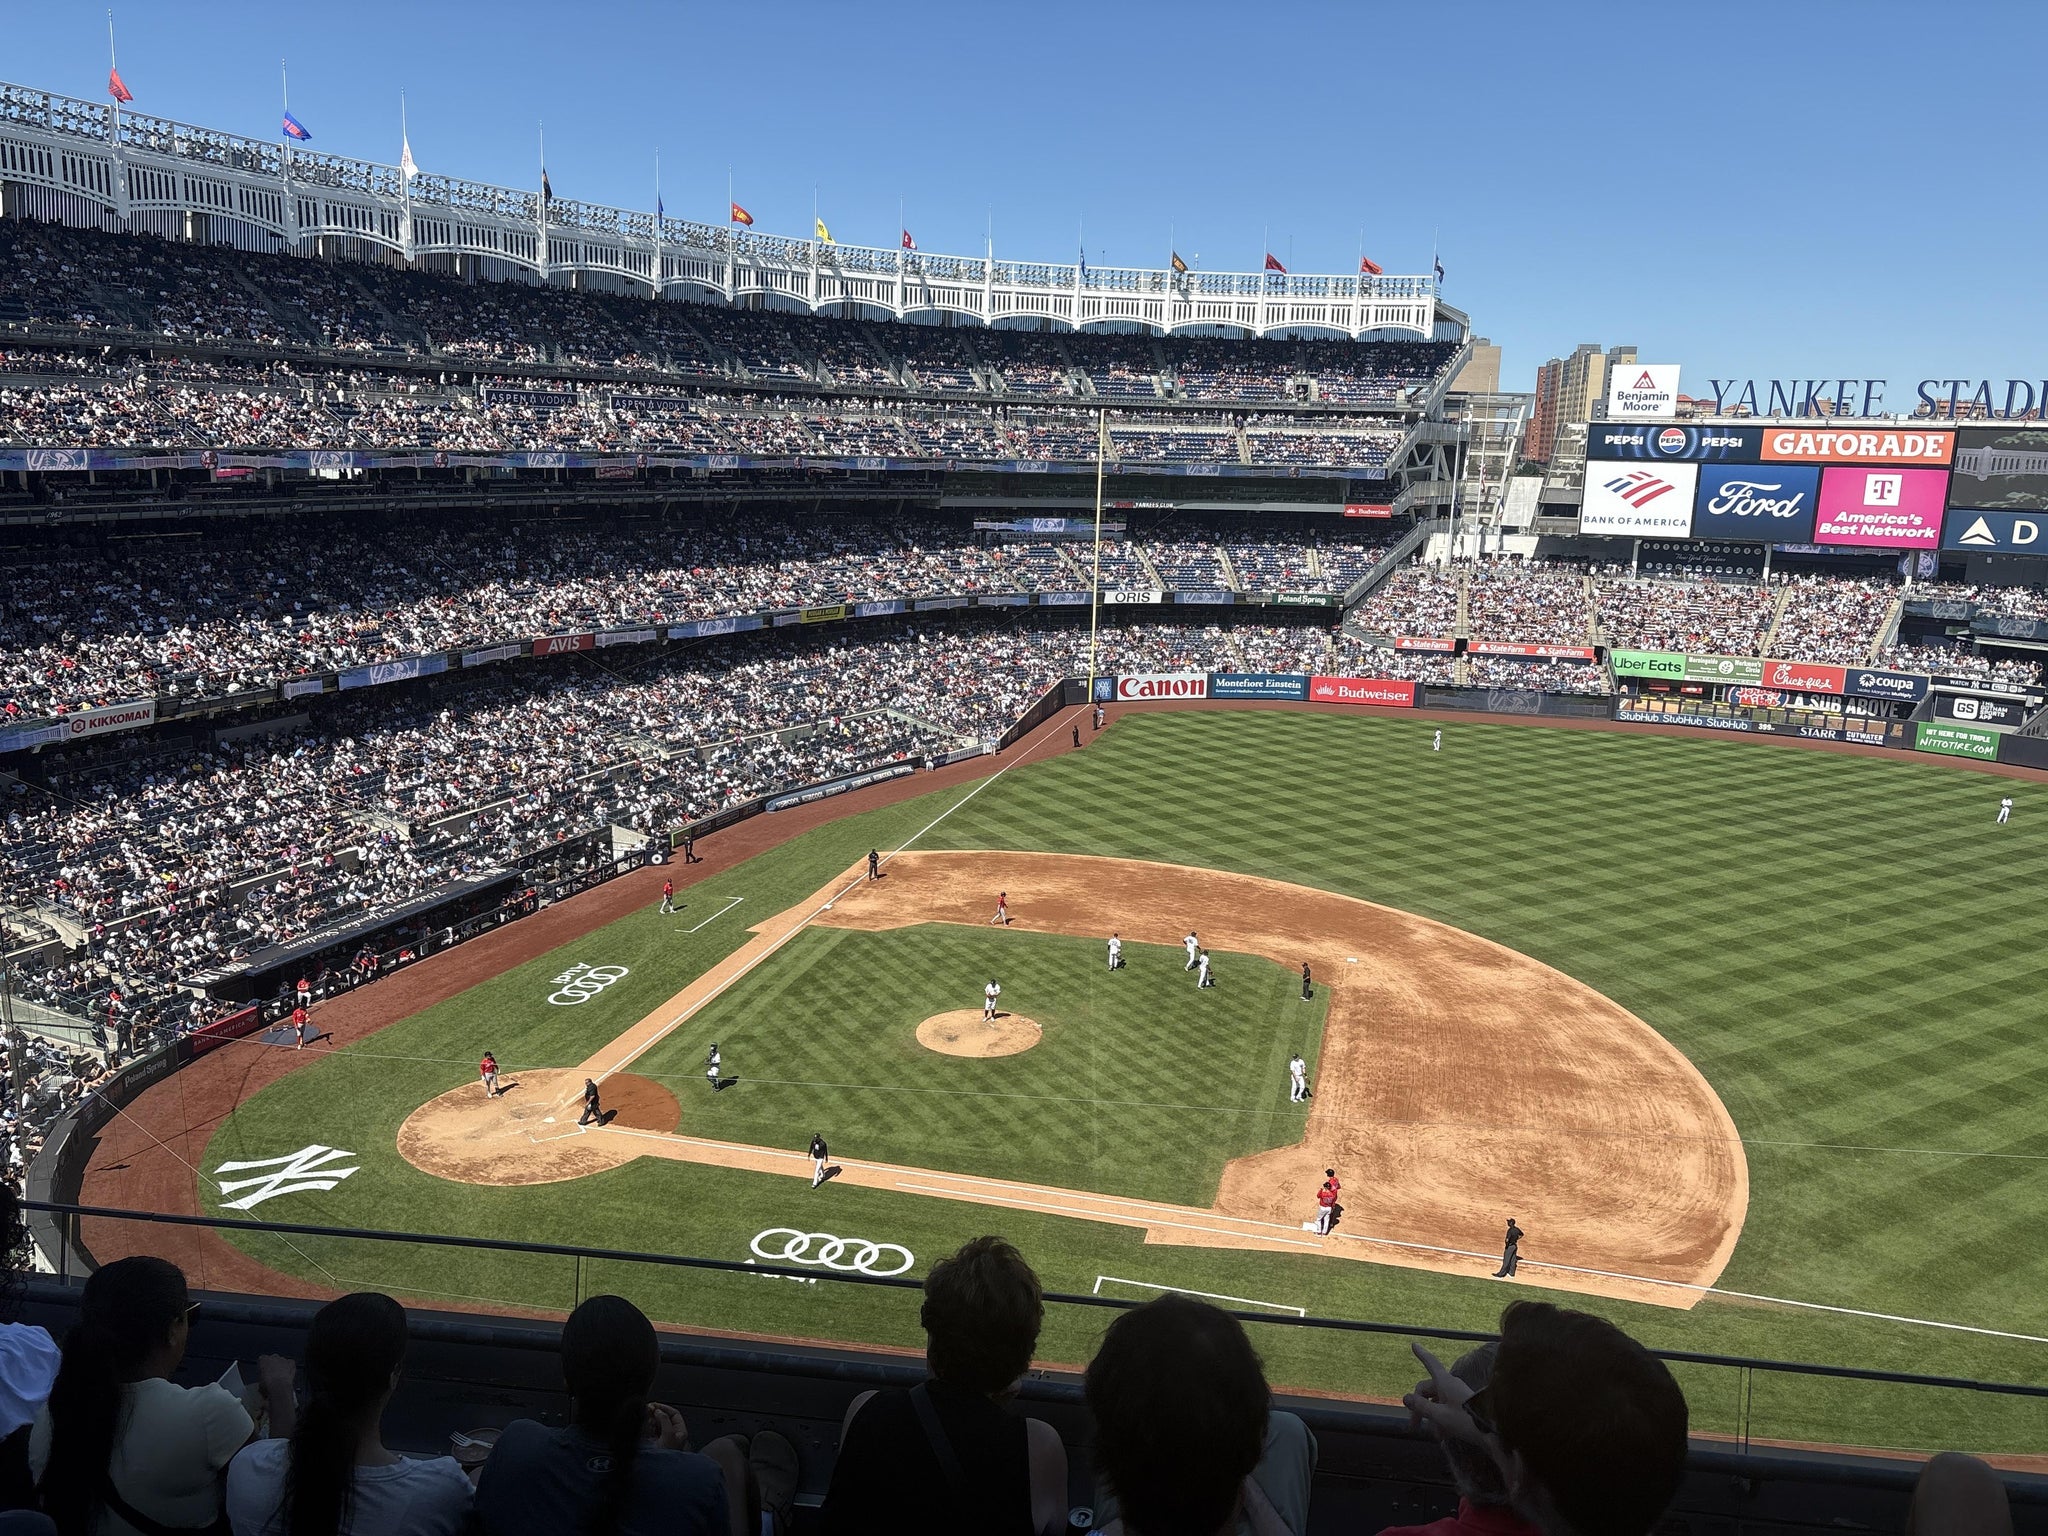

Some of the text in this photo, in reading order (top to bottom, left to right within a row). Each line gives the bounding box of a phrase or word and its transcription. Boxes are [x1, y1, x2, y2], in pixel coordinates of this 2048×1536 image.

[490, 393, 573, 405] ASPEN VODKA
[1617, 391, 1669, 402] Benjamin
[1707, 379, 1888, 417] YANKEE
[657, 401, 685, 410] VODKA
[1622, 402, 1659, 411] Moore
[1605, 435, 1644, 445] PEPSI
[1661, 437, 1684, 445] PEPSI
[1702, 437, 1743, 447] PEPSI
[1773, 433, 1944, 457] GATORADE
[1707, 480, 1804, 518] Ford
[1584, 516, 1687, 527] BANK OF AMERICA
[1833, 511, 1923, 525] America’s
[1818, 523, 1936, 539] Best Network
[2012, 520, 2039, 545] D
[1115, 592, 1150, 603] ORIS
[1277, 594, 1326, 606] Poland Spring
[548, 640, 580, 652] AVIS
[1614, 657, 1646, 669] Uber
[1649, 660, 1682, 672] Eats
[1773, 665, 1832, 689] Chick-fil-A
[1875, 676, 1914, 690] coupa
[1119, 678, 1205, 697] Canon
[1216, 678, 1301, 689] Montefiore Einstein
[1338, 685, 1409, 701] Budweiser
[1794, 693, 1899, 718] A SUB ABOVE
[1957, 702, 1974, 713] GS
[89, 710, 150, 728] KIKKOMAN
[1620, 711, 1659, 722] StubHub
[1663, 714, 1702, 726] StubHub
[1706, 718, 1747, 730] StubHub
[1758, 723, 1771, 731] 399
[1800, 727, 1836, 739] STARR
[1846, 732, 1884, 741] CUTWATER
[1920, 737, 1994, 756] NITTOTIRE.COM
[283, 928, 340, 950] Stadium
[549, 962, 592, 984] Audi
[124, 1058, 167, 1087] Poland Spring
